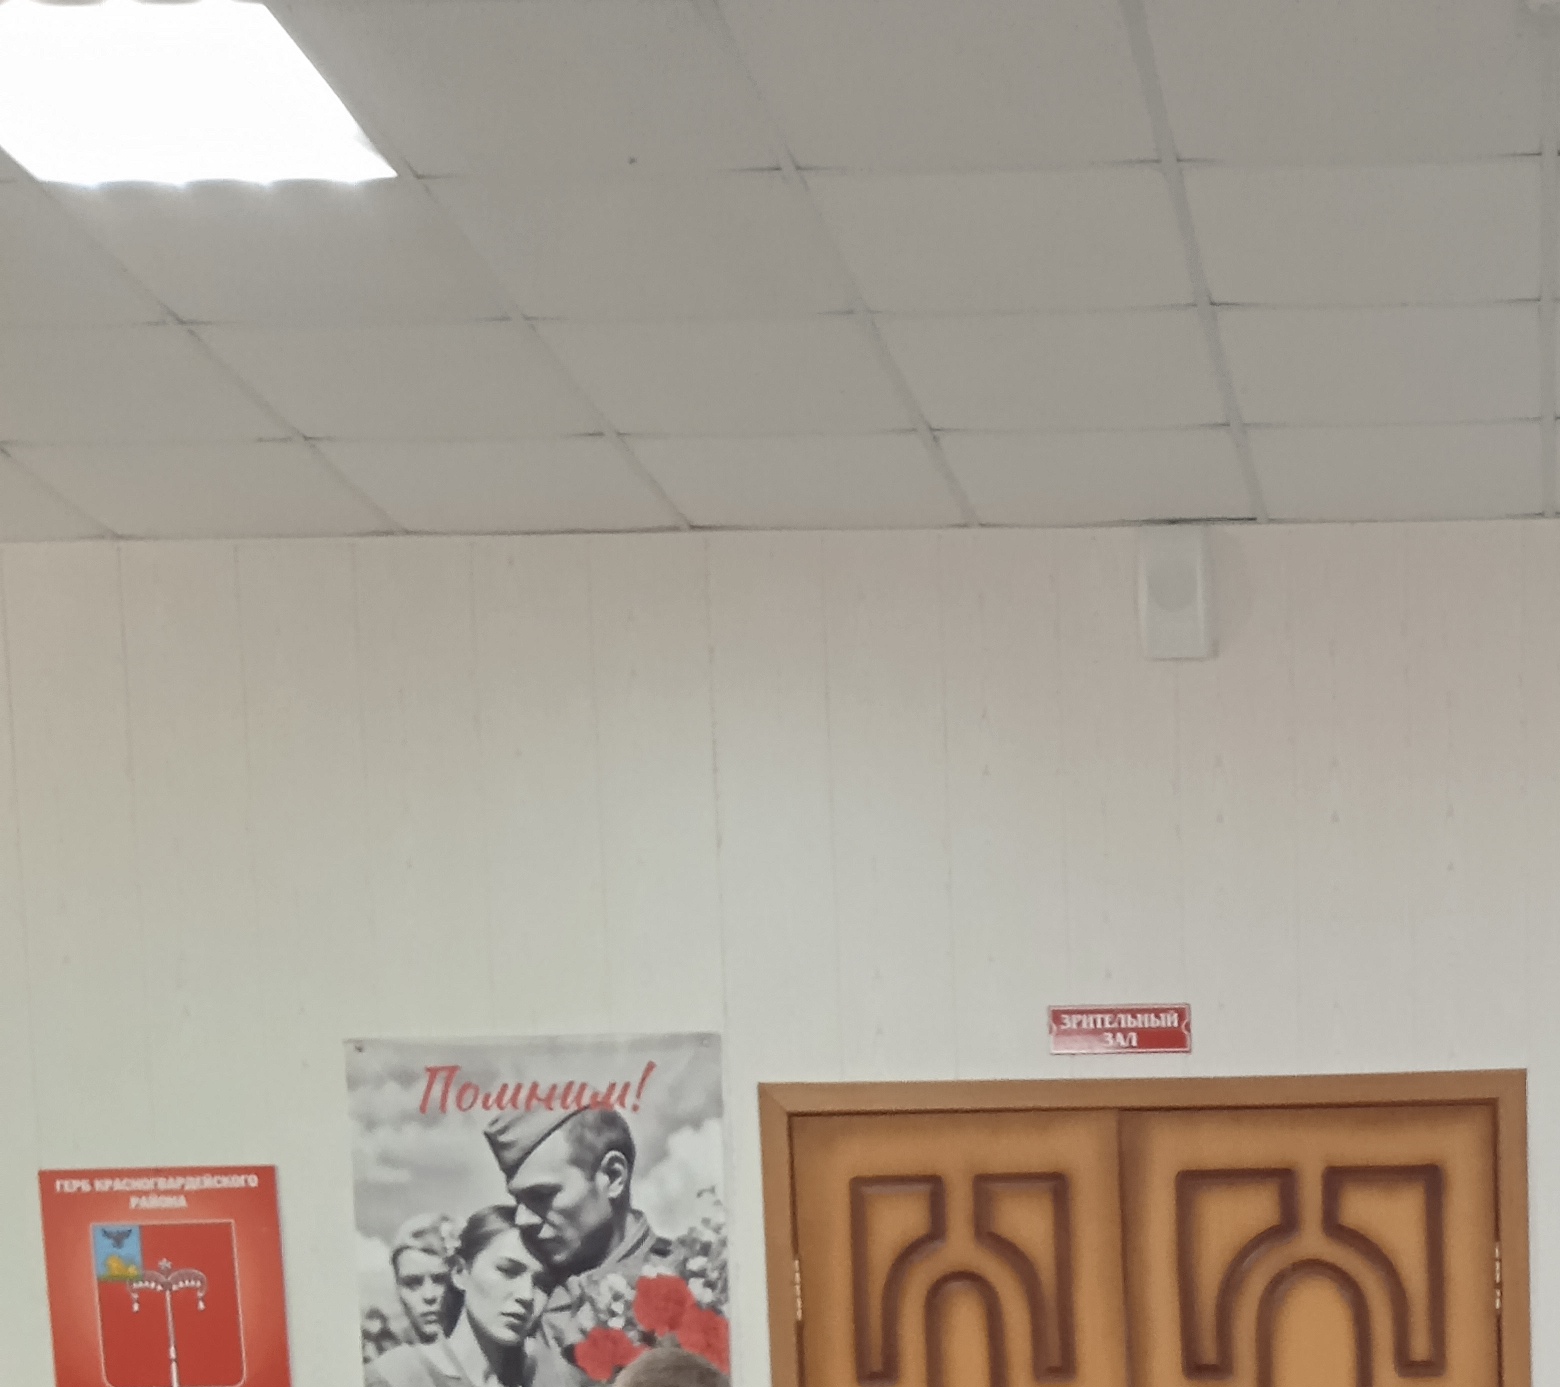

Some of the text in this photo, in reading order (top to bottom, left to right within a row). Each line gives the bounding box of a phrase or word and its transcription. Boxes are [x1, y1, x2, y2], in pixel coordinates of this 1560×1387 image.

[1060, 1010, 1179, 1030] ЗРИТЕЛЬНЫЙ
[1103, 1032, 1138, 1048] ЗАЛ
[419, 1060, 657, 1115] Помним!
[55, 1179, 92, 1193] ГЕРБ
